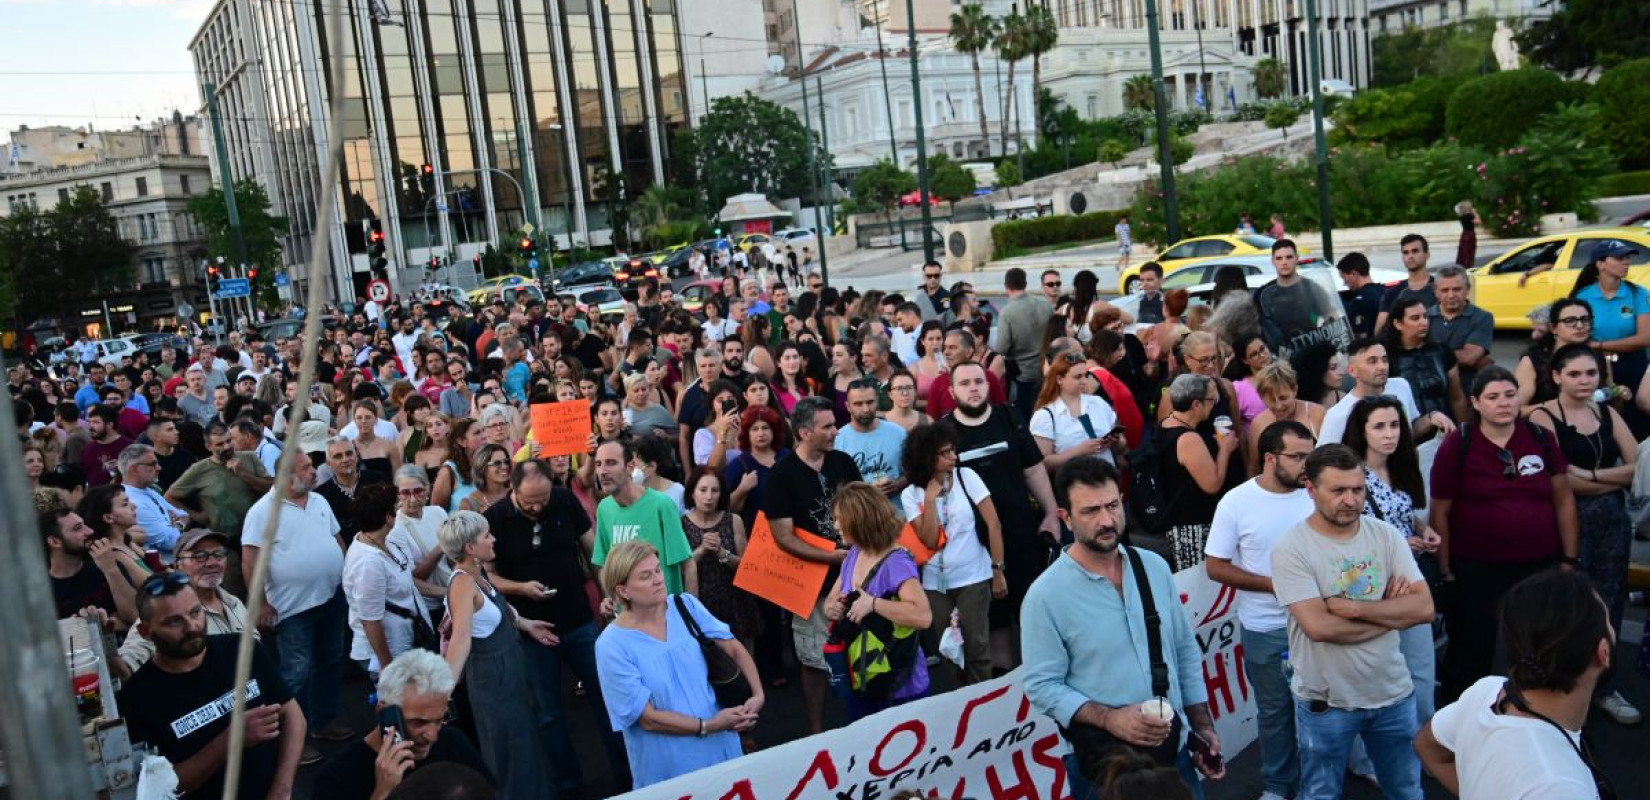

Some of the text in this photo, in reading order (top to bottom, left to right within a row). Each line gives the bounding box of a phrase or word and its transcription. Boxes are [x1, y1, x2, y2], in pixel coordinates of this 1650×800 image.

[175, 714, 199, 735] ONCE
[195, 705, 217, 725] DEAD
[967, 721, 1036, 760] ΑΠΟ
